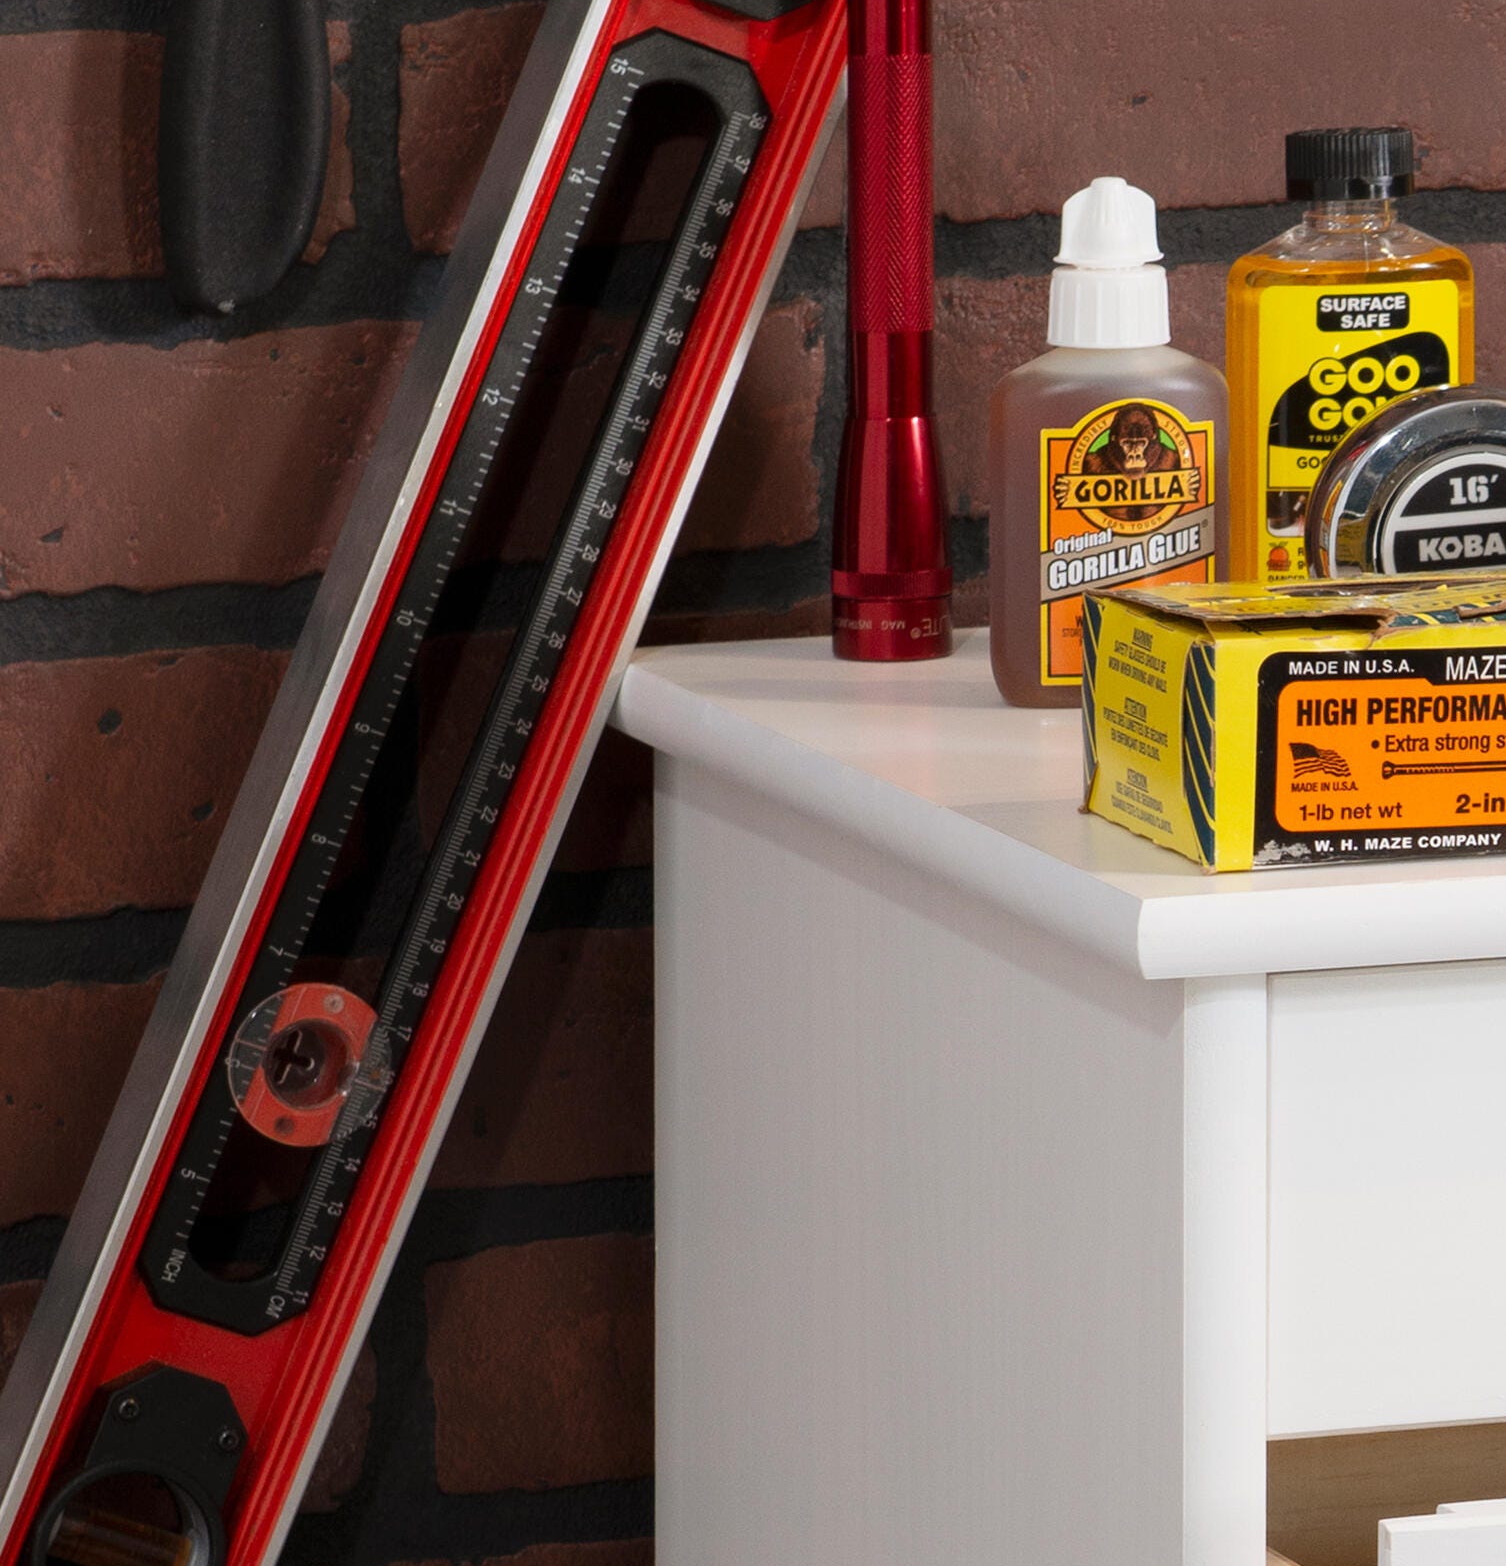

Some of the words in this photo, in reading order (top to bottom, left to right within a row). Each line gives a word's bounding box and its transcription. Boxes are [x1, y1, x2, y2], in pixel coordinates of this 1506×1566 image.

[610, 58, 629, 76] 15
[750, 112, 767, 131] 38
[735, 155, 750, 174] 37
[567, 167, 586, 184] 14
[525, 277, 544, 295] 13
[1320, 295, 1406, 312] SURFACE
[1340, 313, 1390, 329] SAFE
[668, 328, 683, 347] 33
[1309, 354, 1420, 395] GOO
[482, 388, 501, 406] 12
[1309, 396, 1387, 431] GO
[1072, 420, 1108, 471] INCREDIBLY
[617, 458, 634, 477] 30
[1074, 475, 1185, 503] GORILLA
[440, 499, 458, 517] 11
[1054, 528, 1112, 555] Original
[582, 544, 600, 562] 28
[1050, 544, 1145, 590] GORILLA
[1148, 524, 1200, 564] GLUE
[396, 608, 414, 627] 10
[1289, 661, 1338, 675] MADE
[1344, 661, 1360, 674] IN
[1366, 660, 1415, 673] U.S.A.
[1297, 698, 1357, 726] HIGH
[354, 721, 371, 733] 9
[1386, 734, 1429, 752] Extra
[1435, 733, 1490, 753] strong
[1291, 782, 1318, 792] MADE
[1320, 782, 1330, 792] IN
[1333, 781, 1358, 791] U.S.A.
[1299, 804, 1334, 821] 1-lb
[1340, 803, 1371, 820] net
[1378, 802, 1403, 818] wt
[1456, 793, 1505, 813] 2-in
[311, 833, 326, 844] 8
[1315, 839, 1334, 852] W.
[1340, 838, 1358, 851] H.
[1365, 837, 1412, 850] MAZE
[1418, 833, 1501, 848] COMPANY
[269, 945, 284, 956] 7
[161, 1248, 186, 1284] INCH
[265, 1295, 285, 1319] CM
